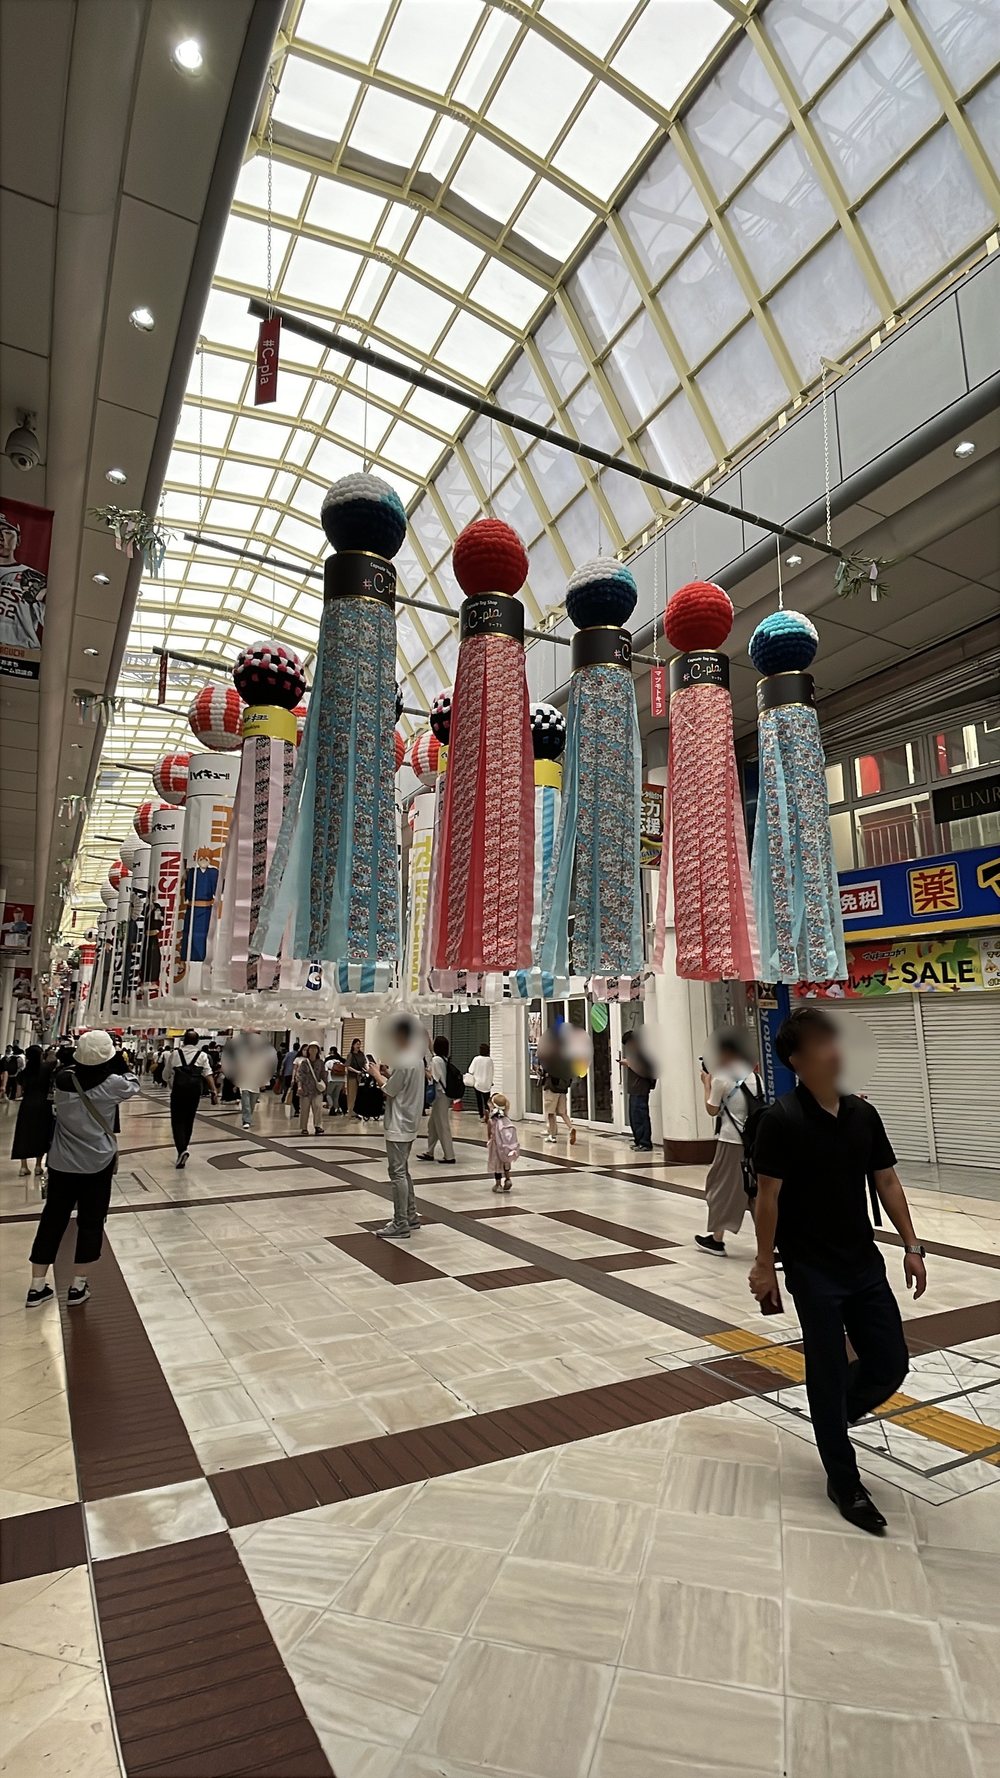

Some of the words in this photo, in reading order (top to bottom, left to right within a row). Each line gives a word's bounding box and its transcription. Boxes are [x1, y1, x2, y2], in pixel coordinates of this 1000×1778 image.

[257, 339, 275, 385] #C-pla
[653, 670, 663, 716] マツモトキヨシ
[841, 889, 878, 911] 免税
[913, 868, 956, 912] 薬
[901, 959, 976, 984] SALE
[762, 1023, 776, 1106] atsumoto
